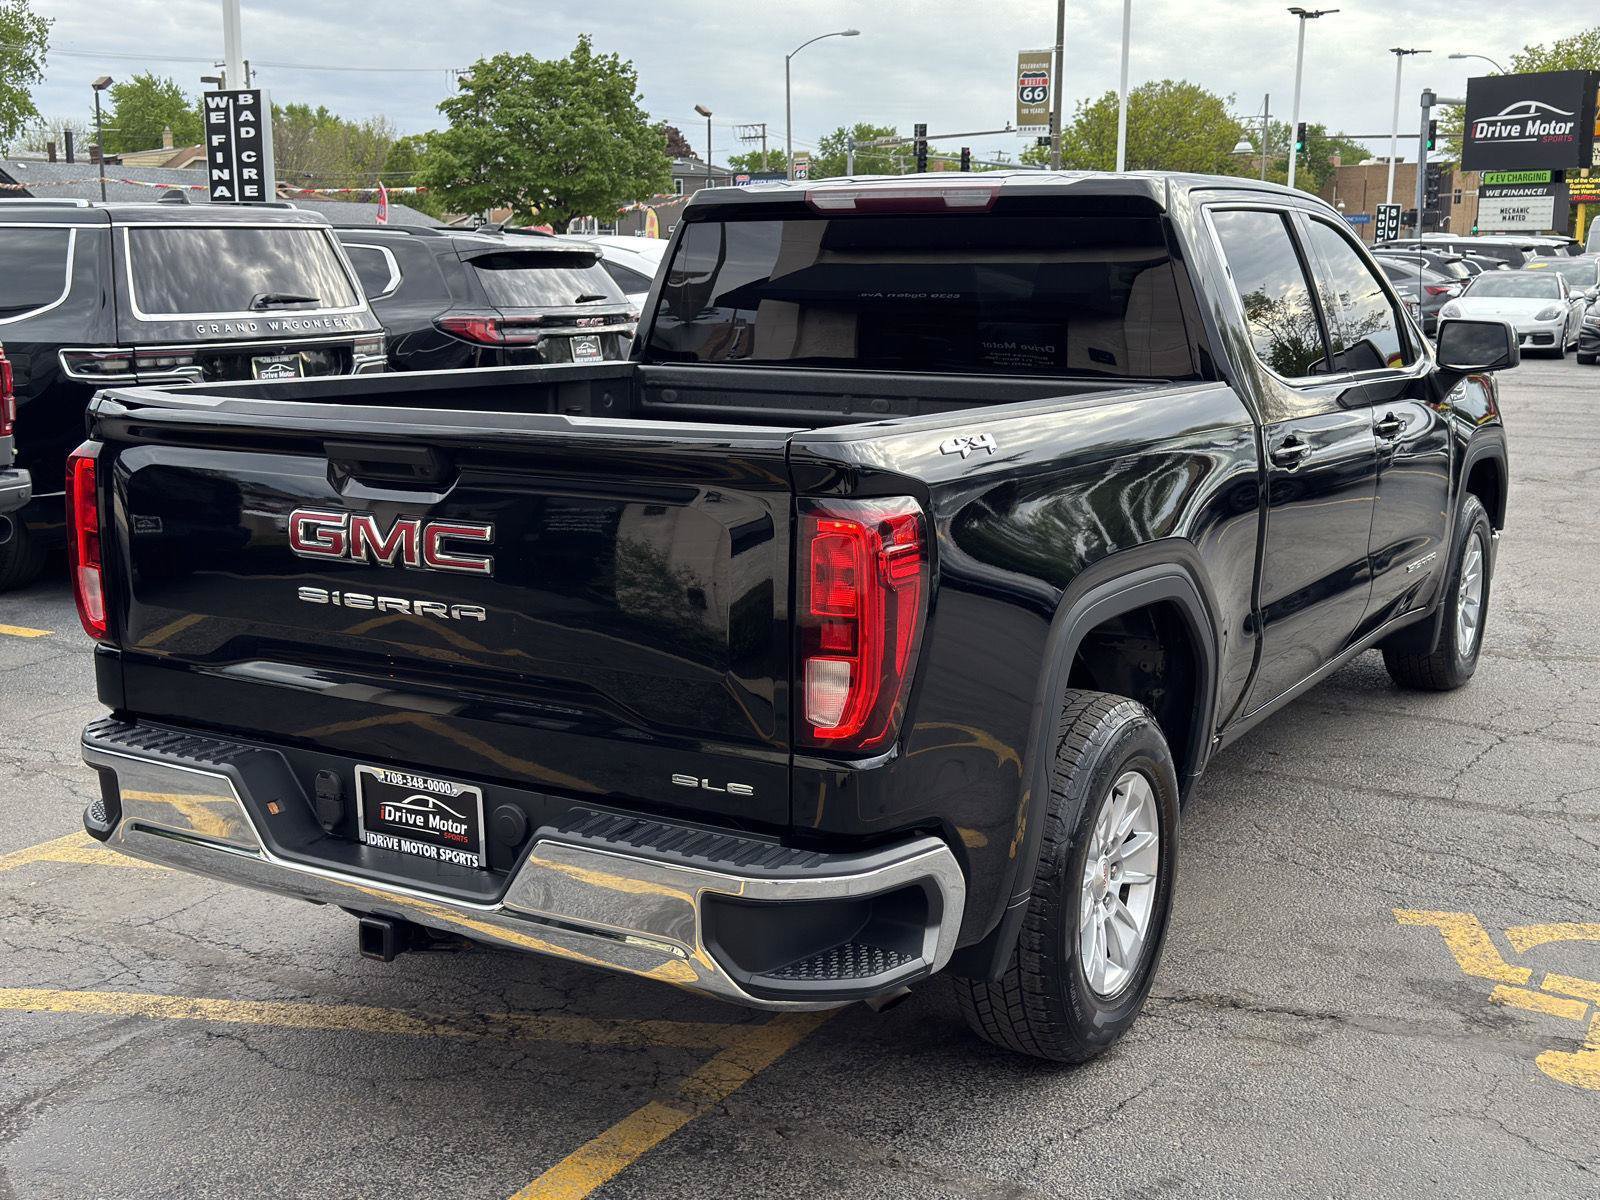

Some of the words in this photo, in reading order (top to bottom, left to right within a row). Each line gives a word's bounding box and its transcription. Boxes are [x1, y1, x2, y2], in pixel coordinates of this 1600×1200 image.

[1023, 87, 1044, 100] 66
[206, 96, 229, 124] WE
[237, 93, 256, 139] BAD
[1471, 122, 1521, 139] iDrive
[1525, 120, 1575, 136] Motor
[1542, 134, 1574, 143] SPORTS
[211, 135, 232, 197] FINA
[241, 151, 259, 197] CRE
[795, 170, 806, 178] 66
[1496, 174, 1505, 183] EV
[1507, 172, 1547, 182] CHARGING
[1485, 189, 1501, 197] WE
[1502, 188, 1547, 196] FINANCE!
[1388, 208, 1398, 238] SUV
[196, 322, 258, 335] GRAND
[269, 318, 352, 331] WAGONEER
[278, 370, 296, 378] Motor
[288, 508, 494, 576] GMC
[298, 586, 487, 621] SIERRA
[385, 771, 451, 794] 708-348-0000
[671, 773, 754, 796] SLE
[380, 806, 424, 826] iDrive
[428, 813, 468, 835] Motor
[443, 832, 469, 843] SPORTS
[400, 840, 438, 859] MOTOR
[439, 848, 479, 868] SPORTS
